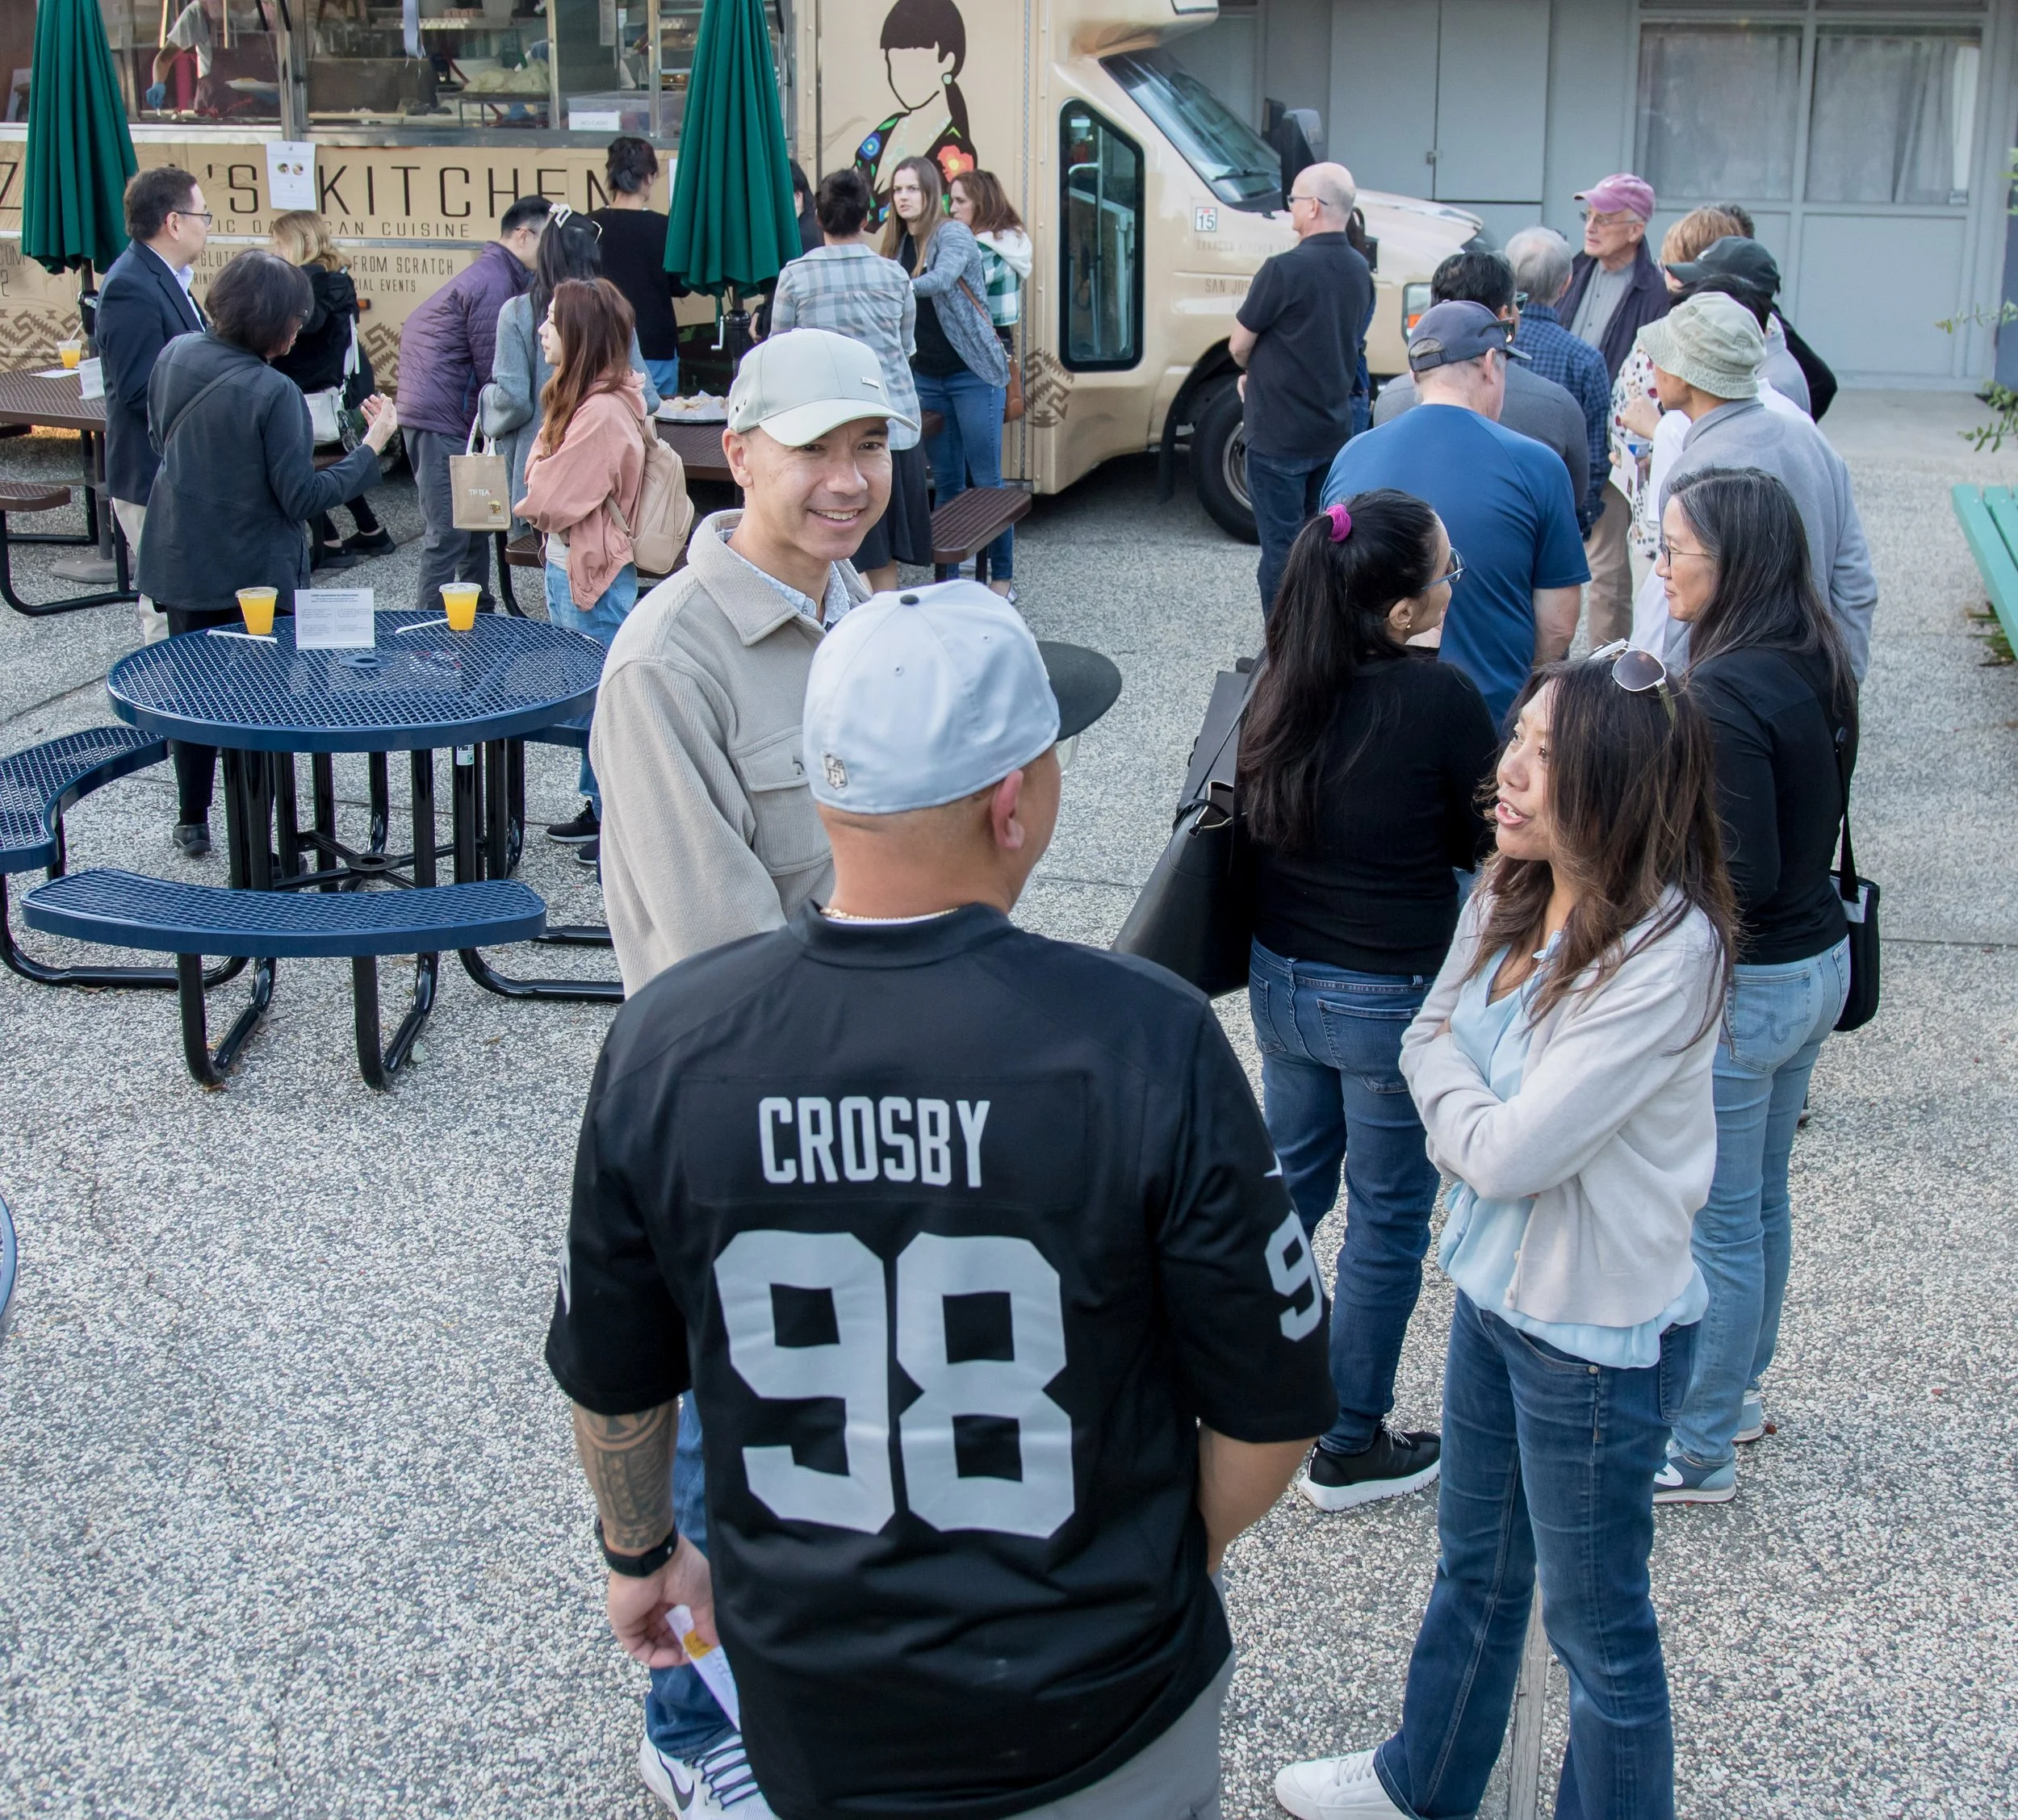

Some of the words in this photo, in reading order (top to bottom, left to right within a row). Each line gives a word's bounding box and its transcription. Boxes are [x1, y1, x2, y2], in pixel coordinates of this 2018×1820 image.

[382, 221, 471, 238] CUISINE
[1198, 215, 1215, 230] 15
[353, 255, 388, 274] FROM
[396, 257, 454, 275] SCRATCH
[380, 278, 417, 293] EVENTS
[1204, 278, 1226, 293] SAN
[479, 489, 491, 497] TEA
[758, 1096, 991, 1188] CROSBY
[1264, 1210, 1329, 1342] 9
[714, 1230, 1075, 1539] 98
